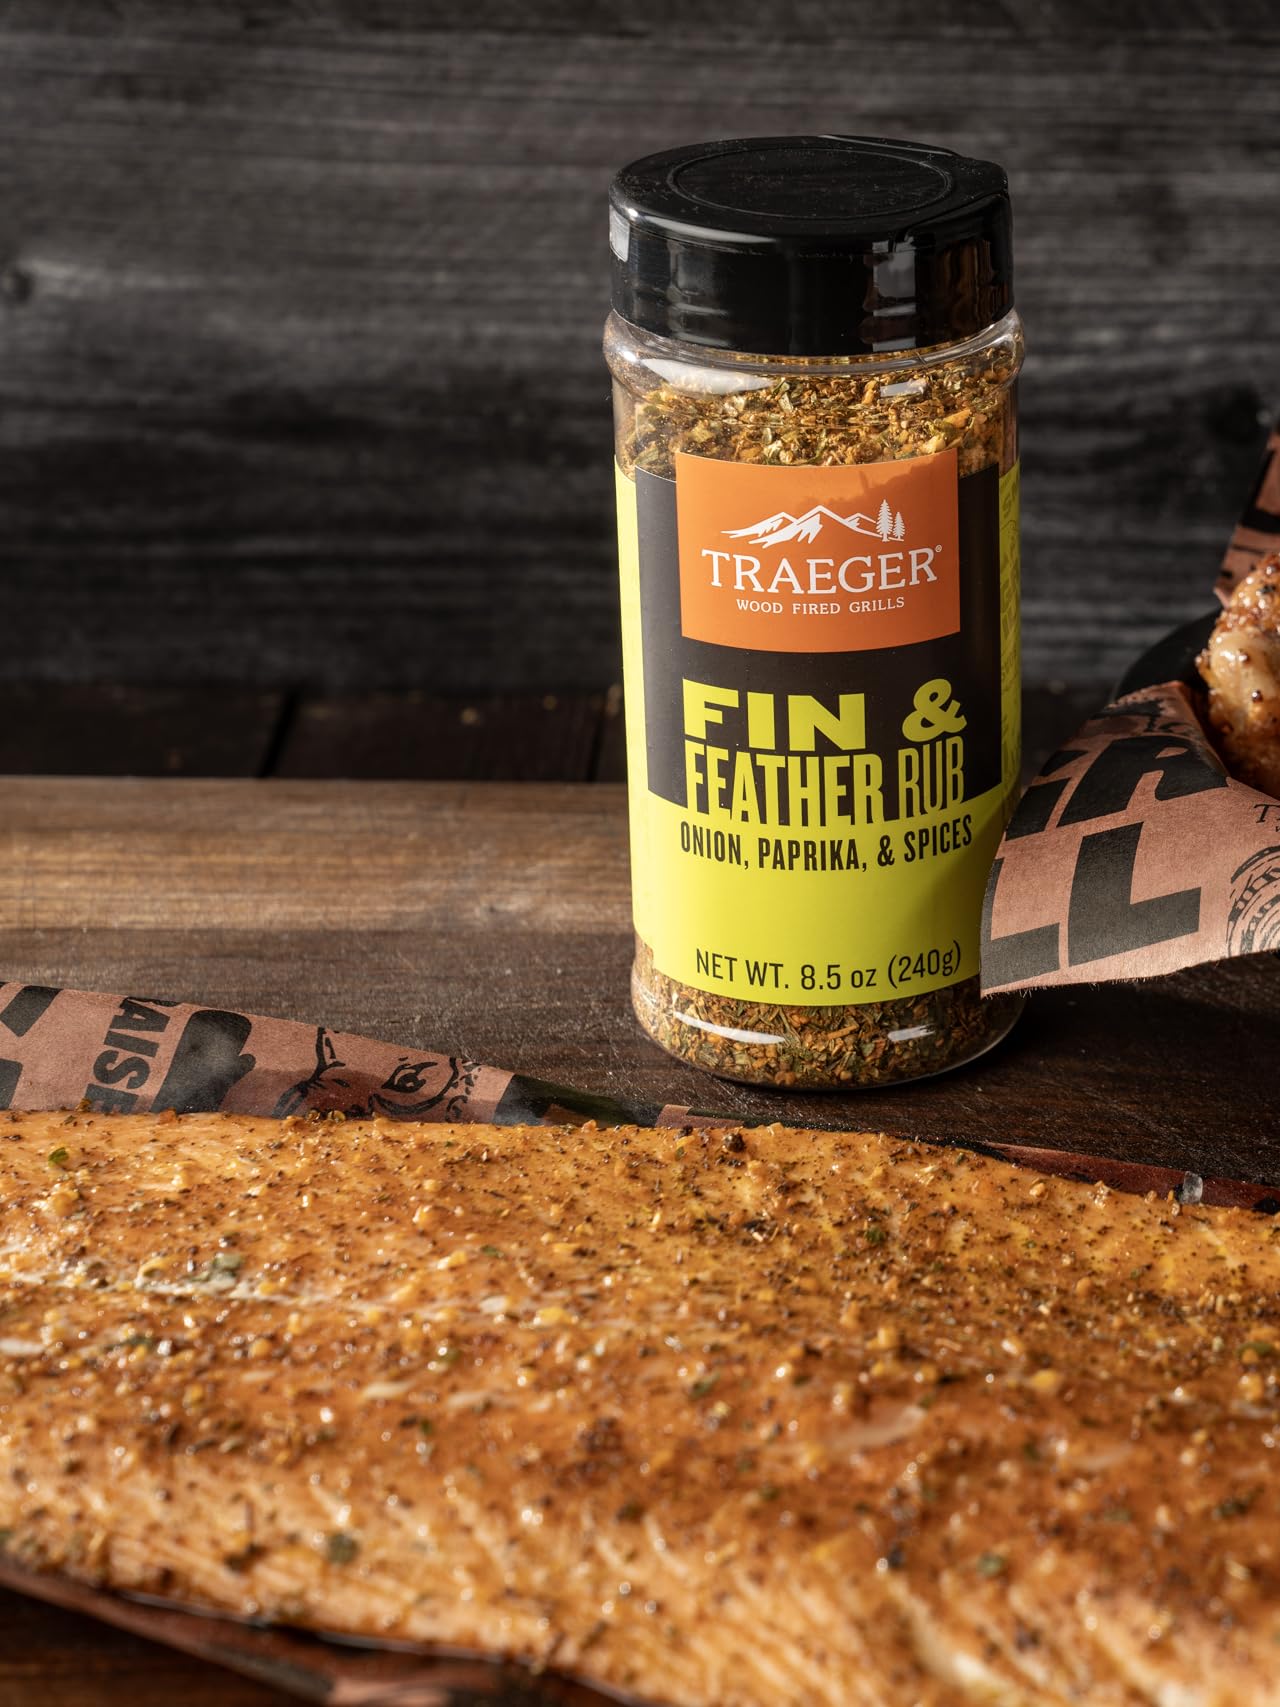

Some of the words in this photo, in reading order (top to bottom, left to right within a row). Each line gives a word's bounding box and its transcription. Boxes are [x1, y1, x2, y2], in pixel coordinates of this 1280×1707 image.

[736, 599, 783, 615] WOOD
[792, 603, 841, 615] FIRED
[849, 596, 905, 613] GRILLS
[682, 678, 866, 752] FIN
[901, 678, 968, 742] &
[684, 738, 885, 829] FEATHER
[898, 735, 965, 820] RUB
[680, 820, 749, 870] ONION,
[758, 837, 868, 872] PAPRIKA,
[877, 834, 895, 867] &
[904, 813, 973, 863] SPICES
[696, 947, 737, 982] NET
[745, 959, 789, 989] WT.
[801, 964, 841, 990] 8.5
[850, 968, 876, 988] oz
[888, 939, 961, 989] (240g)
